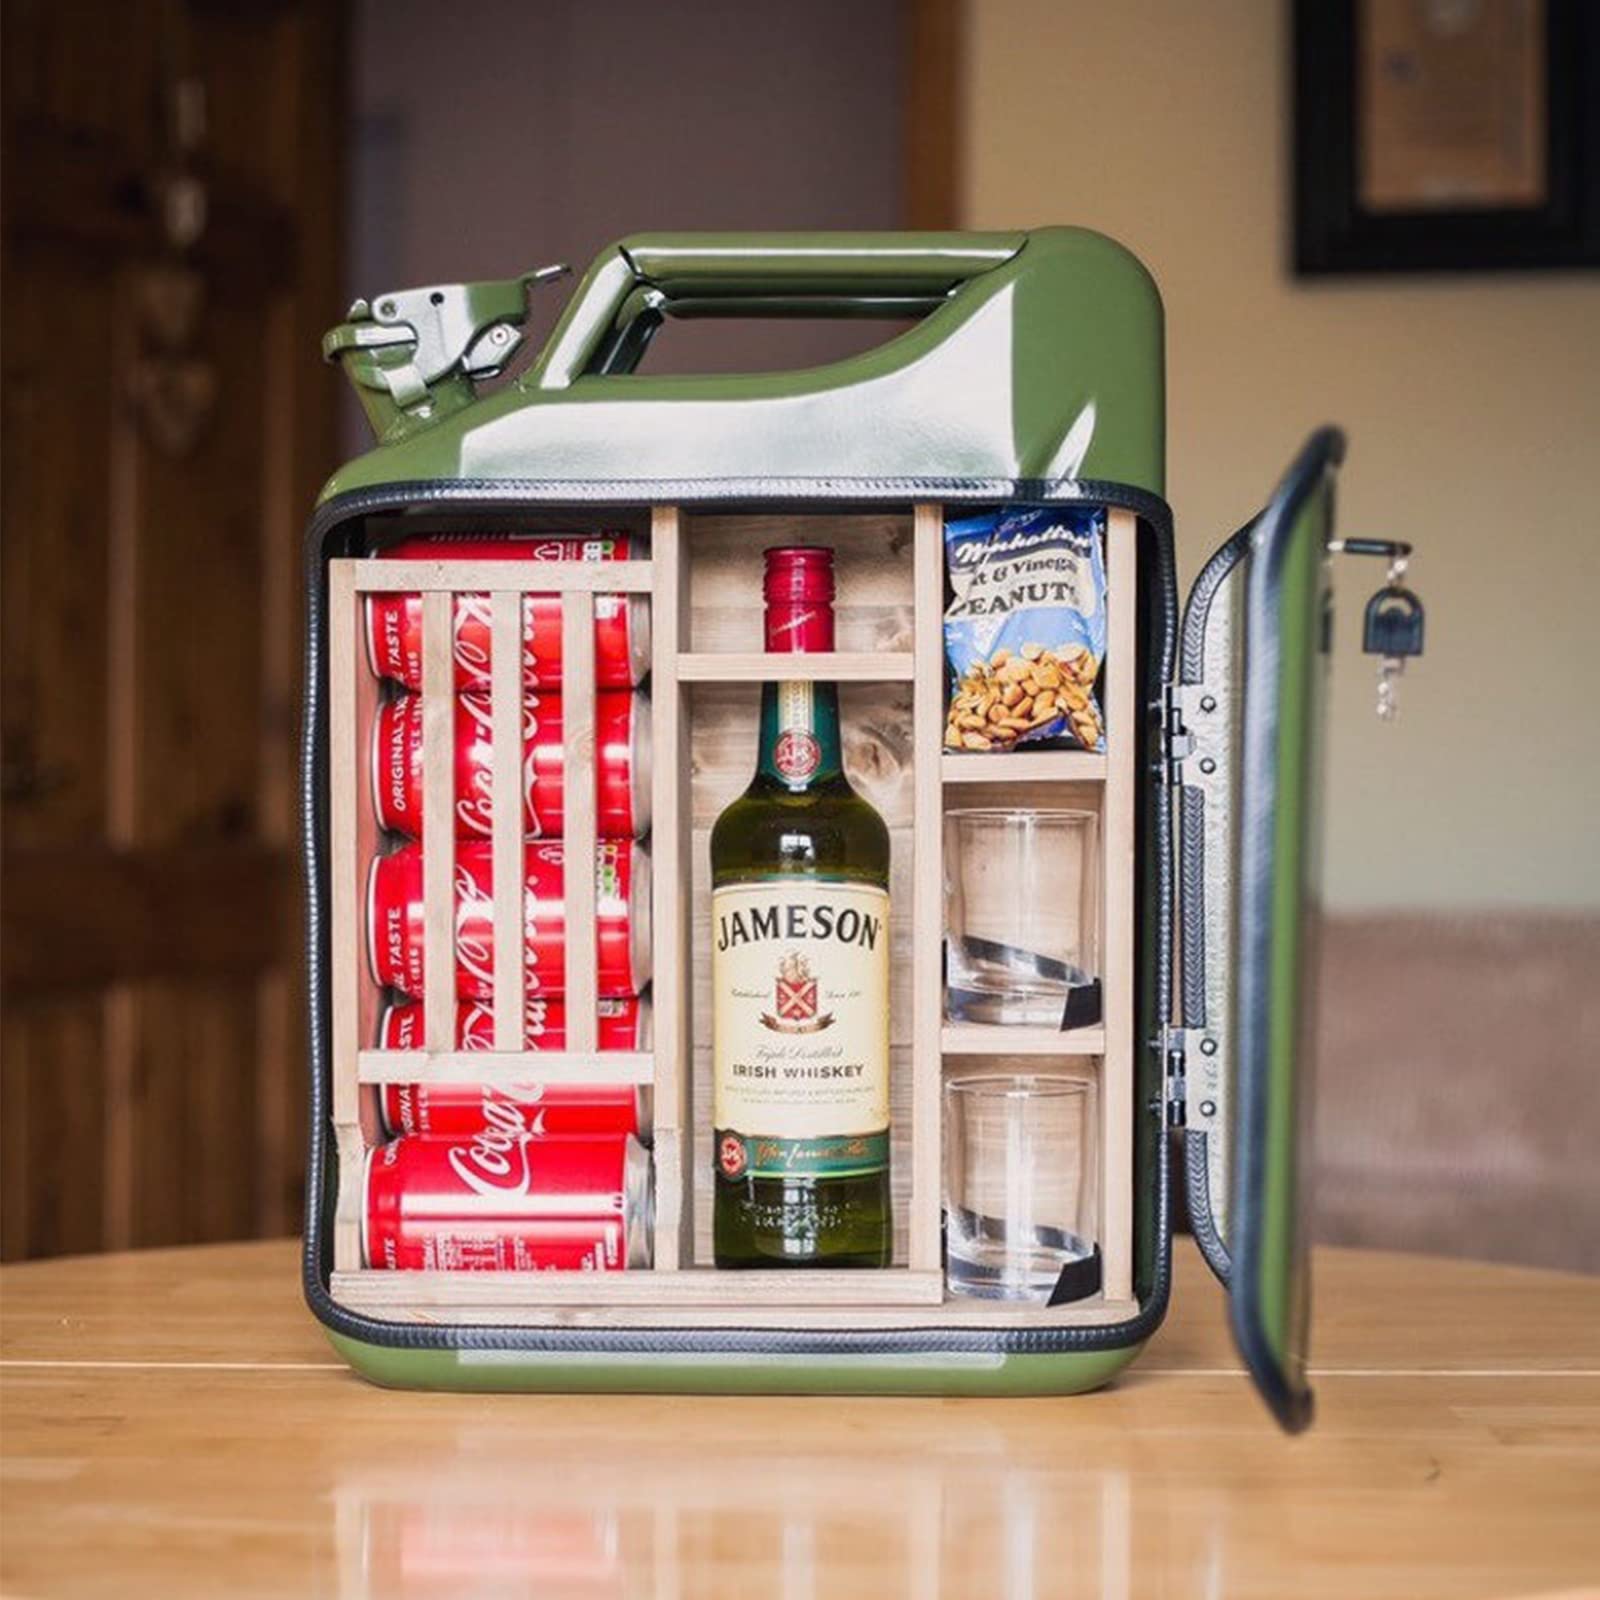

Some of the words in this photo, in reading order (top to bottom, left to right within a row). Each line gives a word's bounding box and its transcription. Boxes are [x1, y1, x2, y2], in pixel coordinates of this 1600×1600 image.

[384, 609, 402, 666] TASTE
[391, 722, 406, 811] ORIGINAL
[388, 907, 403, 966] TASTE
[717, 905, 879, 952] JAMESON
[732, 1063, 777, 1079] IRISH
[783, 1063, 865, 1079] WHISKEY
